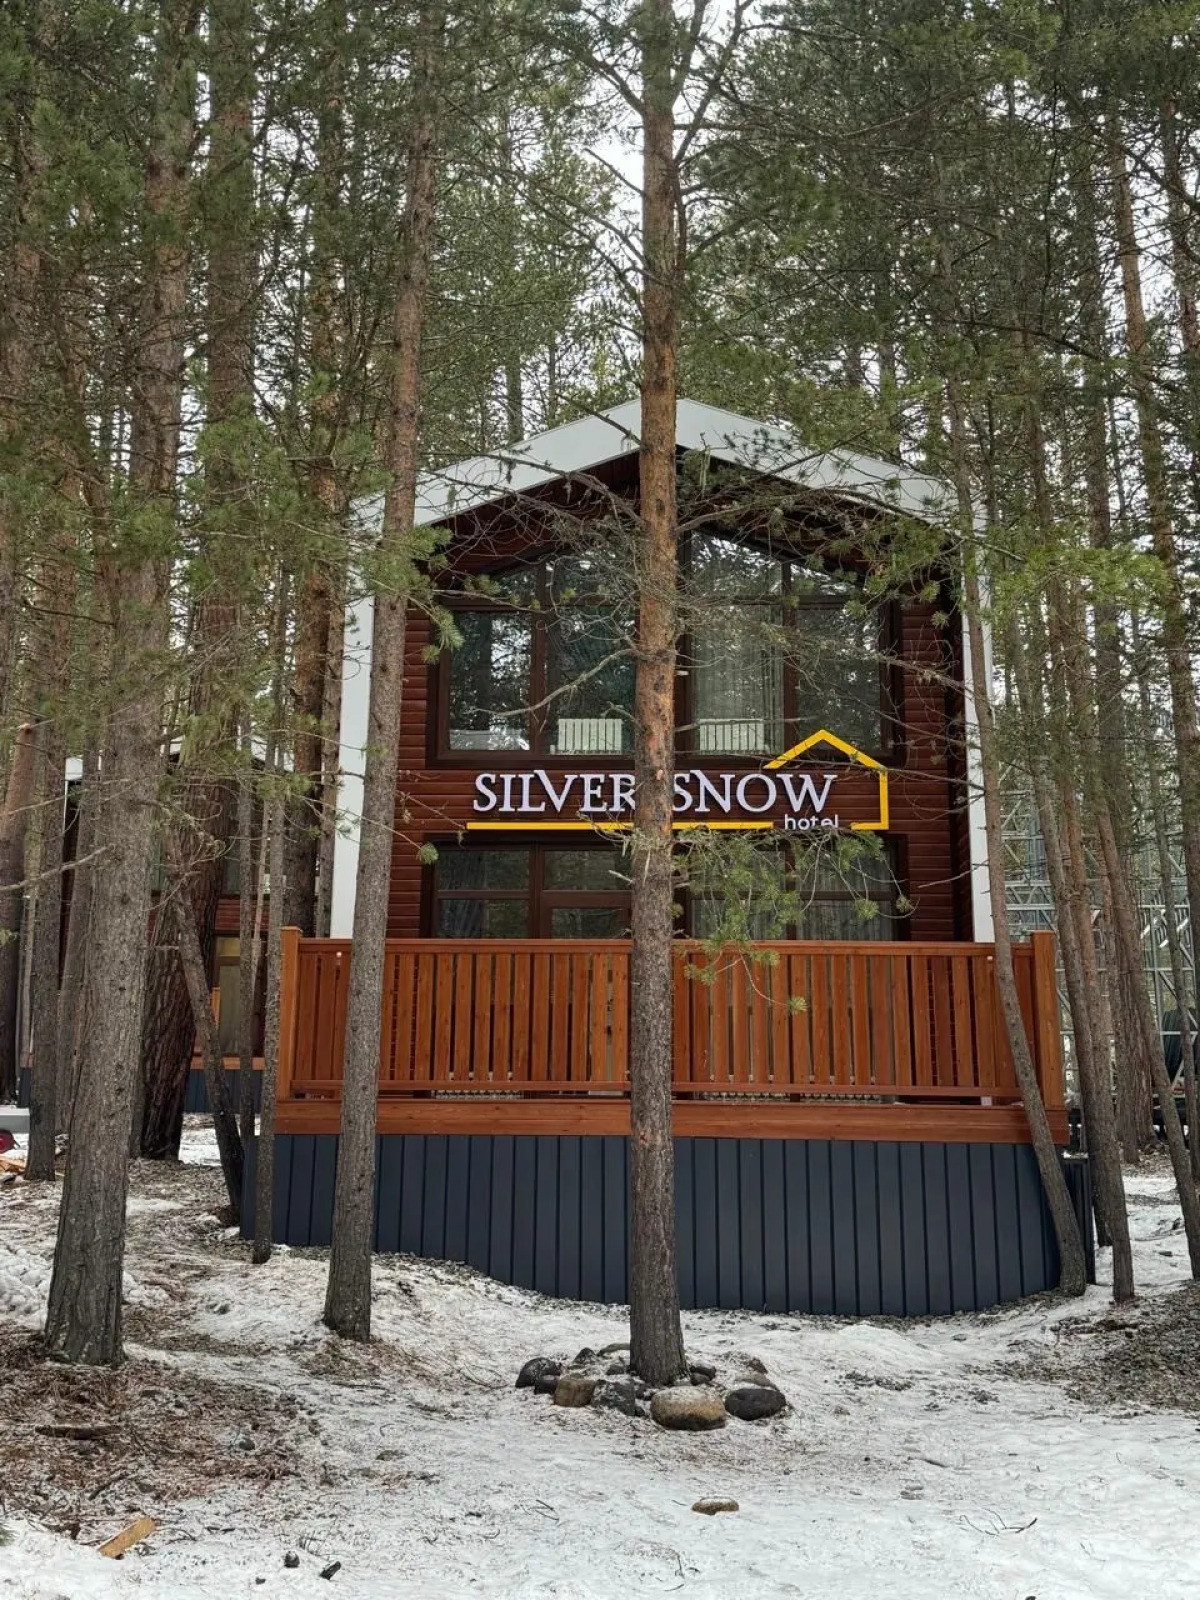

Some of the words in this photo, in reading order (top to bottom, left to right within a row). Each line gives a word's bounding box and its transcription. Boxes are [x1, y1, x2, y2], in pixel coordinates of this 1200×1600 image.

[473, 769, 636, 813] SILVER
[672, 769, 838, 813] SNOW
[784, 813, 839, 831] hotel
